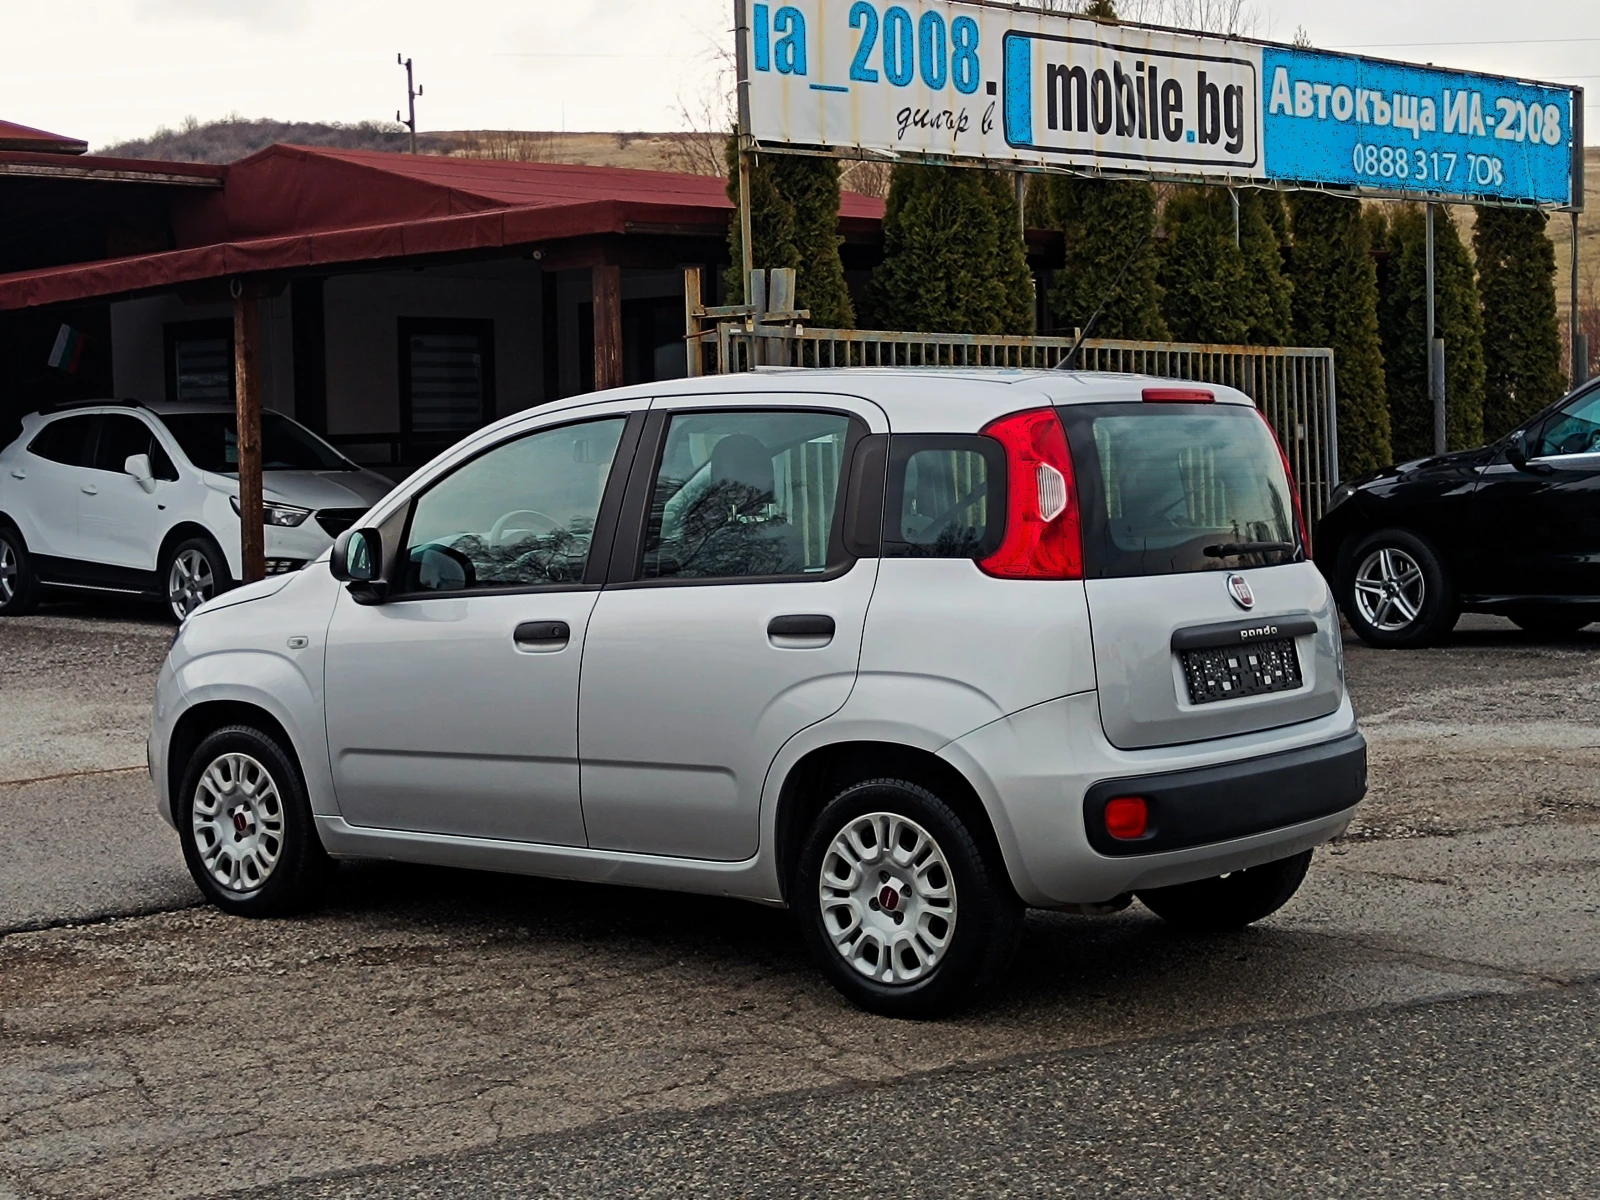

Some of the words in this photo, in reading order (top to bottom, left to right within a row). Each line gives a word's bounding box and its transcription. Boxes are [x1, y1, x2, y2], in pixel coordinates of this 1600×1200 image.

[896, 104, 970, 141] дилър
[1046, 60, 1244, 154] mobile.bg
[1269, 66, 1436, 140] Автокъща
[1443, 88, 1562, 147] ИА-2008
[1353, 143, 1409, 180] 0888
[1414, 150, 1457, 183] 317
[1466, 153, 1504, 186] 708
[1240, 625, 1278, 641] panda
